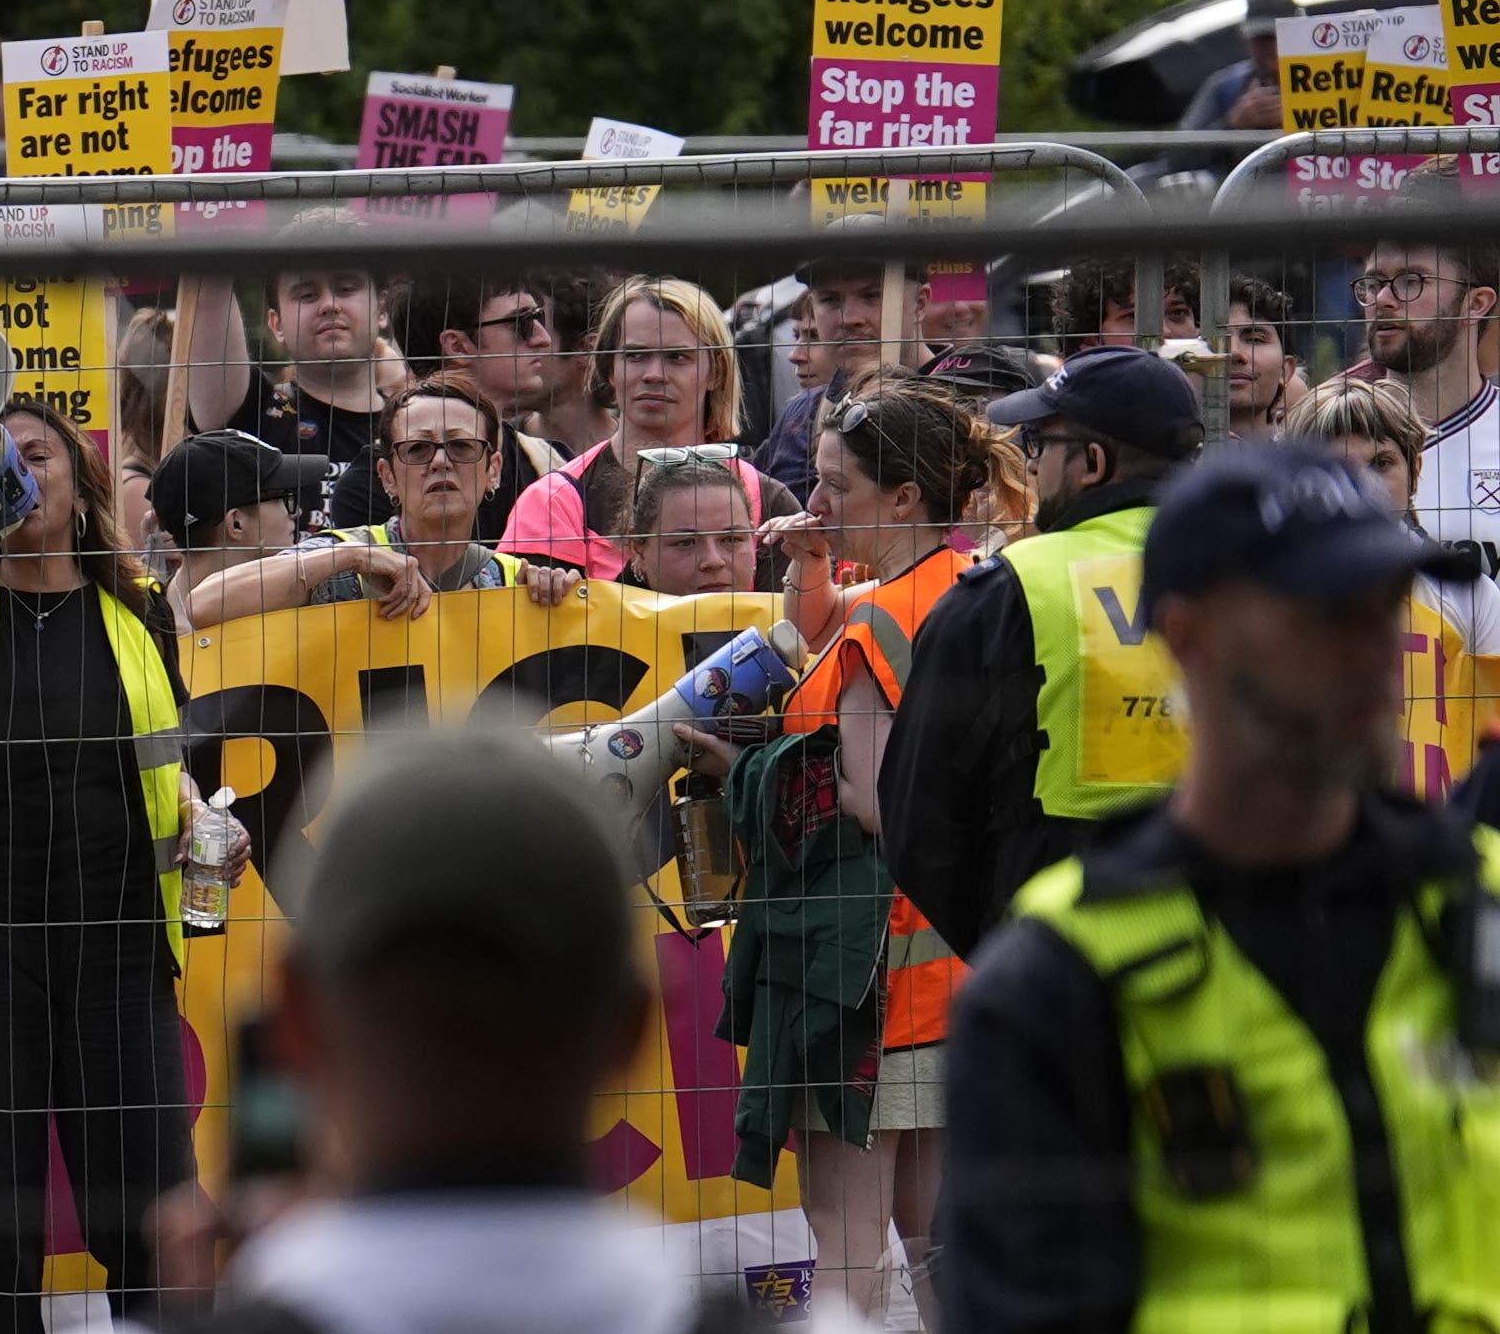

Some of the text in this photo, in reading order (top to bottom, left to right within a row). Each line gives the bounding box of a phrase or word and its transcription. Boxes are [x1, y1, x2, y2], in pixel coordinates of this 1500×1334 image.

[199, 11, 255, 25] TO RACISM
[825, 14, 983, 50] welcome
[72, 43, 128, 59] STAND UP
[73, 56, 133, 72] TO RACISM
[169, 39, 273, 81] efugees
[19, 80, 149, 121] Far right
[170, 81, 262, 113] elcome
[820, 67, 976, 113] Stop the
[21, 122, 129, 158] are not
[376, 103, 480, 147] SMASH
[819, 110, 971, 147] far right
[213, 135, 253, 168] the
[374, 141, 427, 168] THE
[4, 222, 55, 239] RACISM
[30, 207, 48, 222] UP
